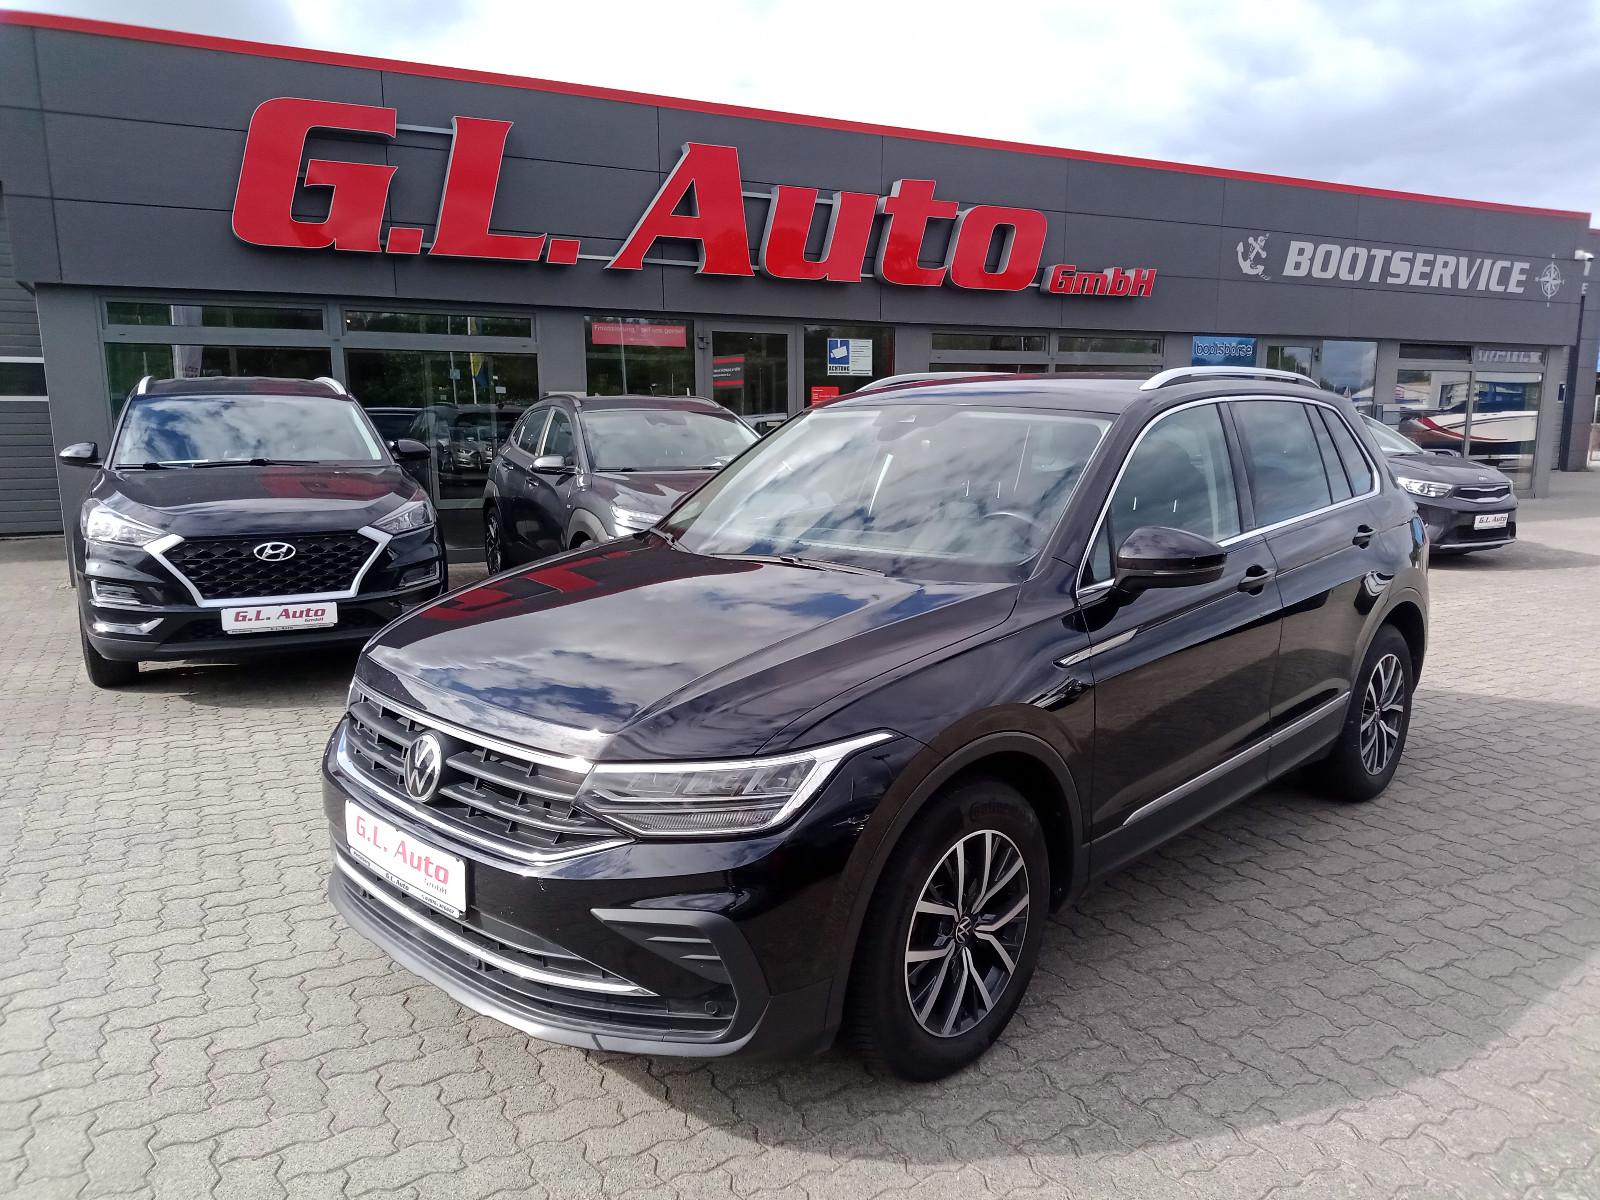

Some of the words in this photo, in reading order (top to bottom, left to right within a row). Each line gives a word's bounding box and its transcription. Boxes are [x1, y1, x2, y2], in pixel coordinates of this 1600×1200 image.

[231, 97, 581, 265] G.L.
[603, 141, 1048, 292] Auto
[1041, 264, 1157, 298] GmbH
[1282, 240, 1531, 294] BOOTSERVICE
[233, 611, 271, 623] G.L.
[276, 607, 327, 619] Auto
[356, 815, 388, 852] G.L.
[394, 840, 450, 885] Auto
